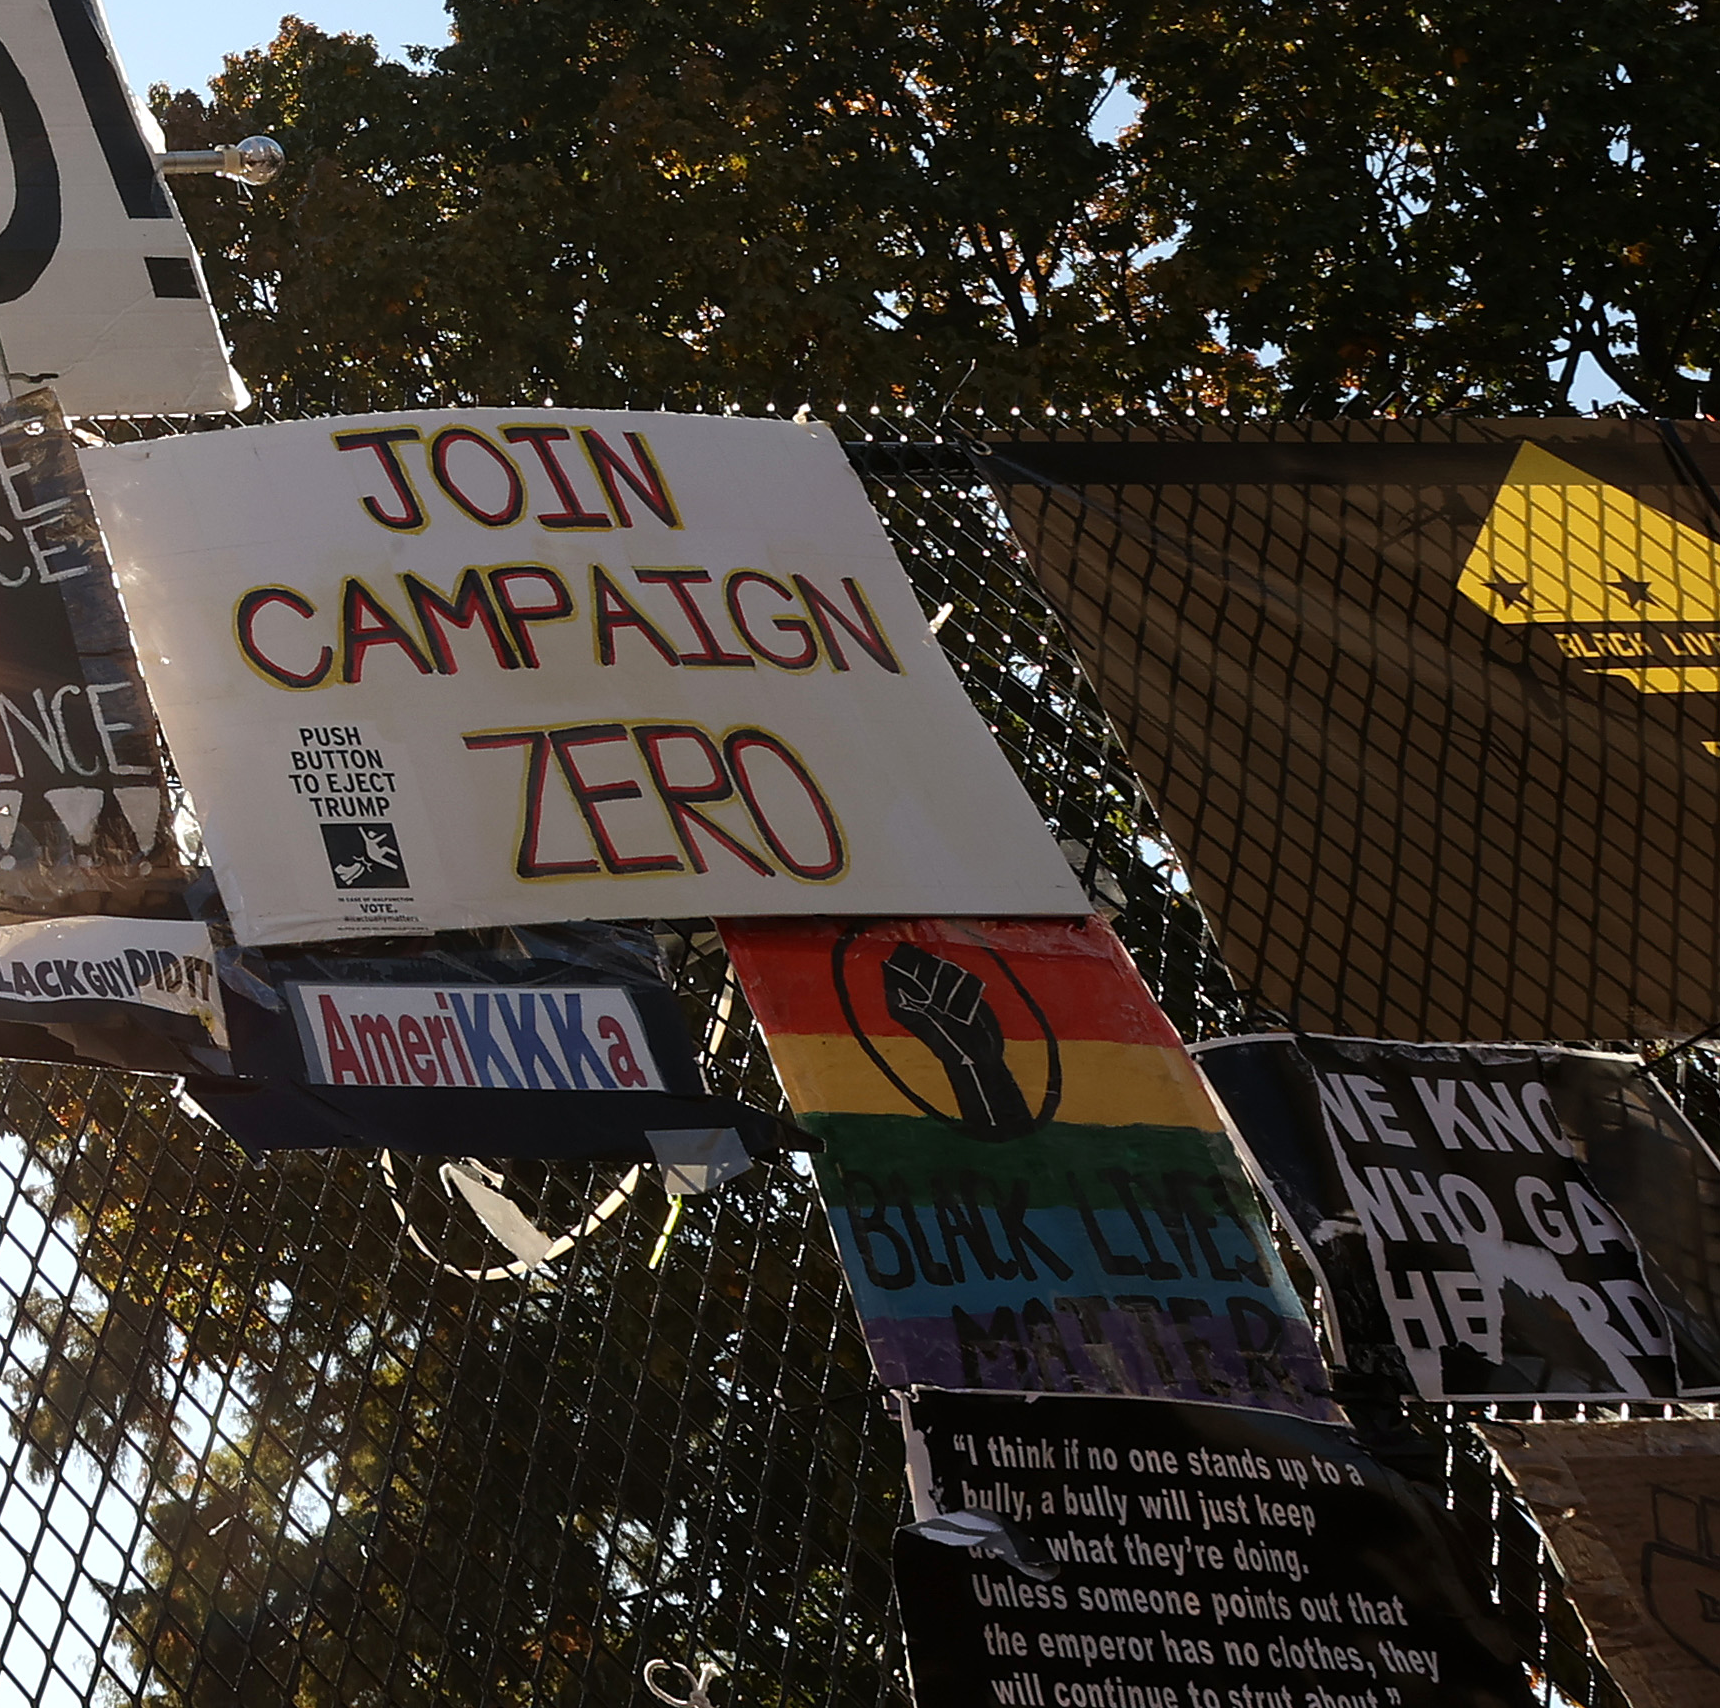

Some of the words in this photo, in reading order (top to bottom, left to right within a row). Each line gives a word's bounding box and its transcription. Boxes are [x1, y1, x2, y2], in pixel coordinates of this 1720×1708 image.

[330, 423, 685, 534] JOIN
[231, 562, 906, 690] CAMPAIGN
[1554, 632, 1654, 658] BLACK
[291, 749, 384, 770] BUTTON
[299, 726, 362, 747] PUSH
[288, 774, 320, 794] TO
[325, 772, 397, 793] EJECT
[309, 796, 391, 817] TRUMP
[461, 720, 851, 885] ZERO
[360, 903, 398, 914] VOTE.
[82, 957, 134, 999] GUY
[123, 949, 186, 993] DID
[183, 955, 214, 1001] IT
[318, 992, 648, 1089] AmeriKKKa
[843, 1168, 1075, 1290] BLACK
[1066, 1166, 1275, 1288] LIVES
[972, 1575, 1068, 1611] Unless
[1079, 1583, 1201, 1616] someone
[1211, 1589, 1291, 1625] points
[1300, 1594, 1341, 1623] out
[1347, 1592, 1409, 1626] that
[984, 1624, 1028, 1658] the
[1039, 1632, 1154, 1667] emperor
[1161, 1630, 1214, 1666] has
[1224, 1640, 1259, 1668] no
[1267, 1635, 1376, 1678] clothes,
[1379, 1642, 1439, 1684] they
